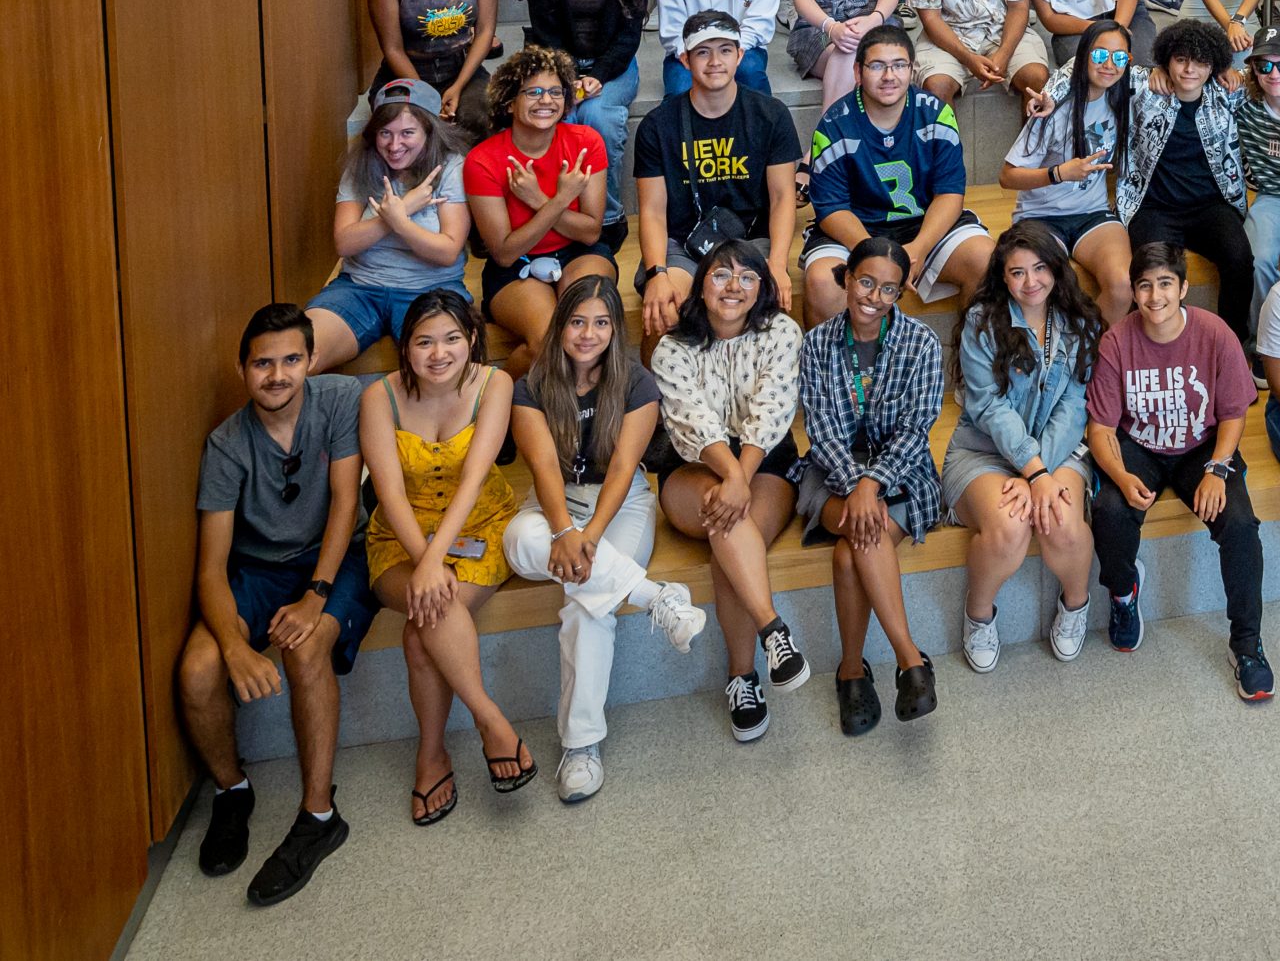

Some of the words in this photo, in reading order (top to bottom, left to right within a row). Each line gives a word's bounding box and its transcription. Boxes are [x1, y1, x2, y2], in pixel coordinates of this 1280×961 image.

[874, 159, 925, 222] 3
[1125, 368, 1161, 393] LIFE
[1167, 367, 1184, 391] IS
[1126, 389, 1187, 413] BETTER
[1155, 406, 1189, 428] THE
[1128, 418, 1188, 449] LAKE
